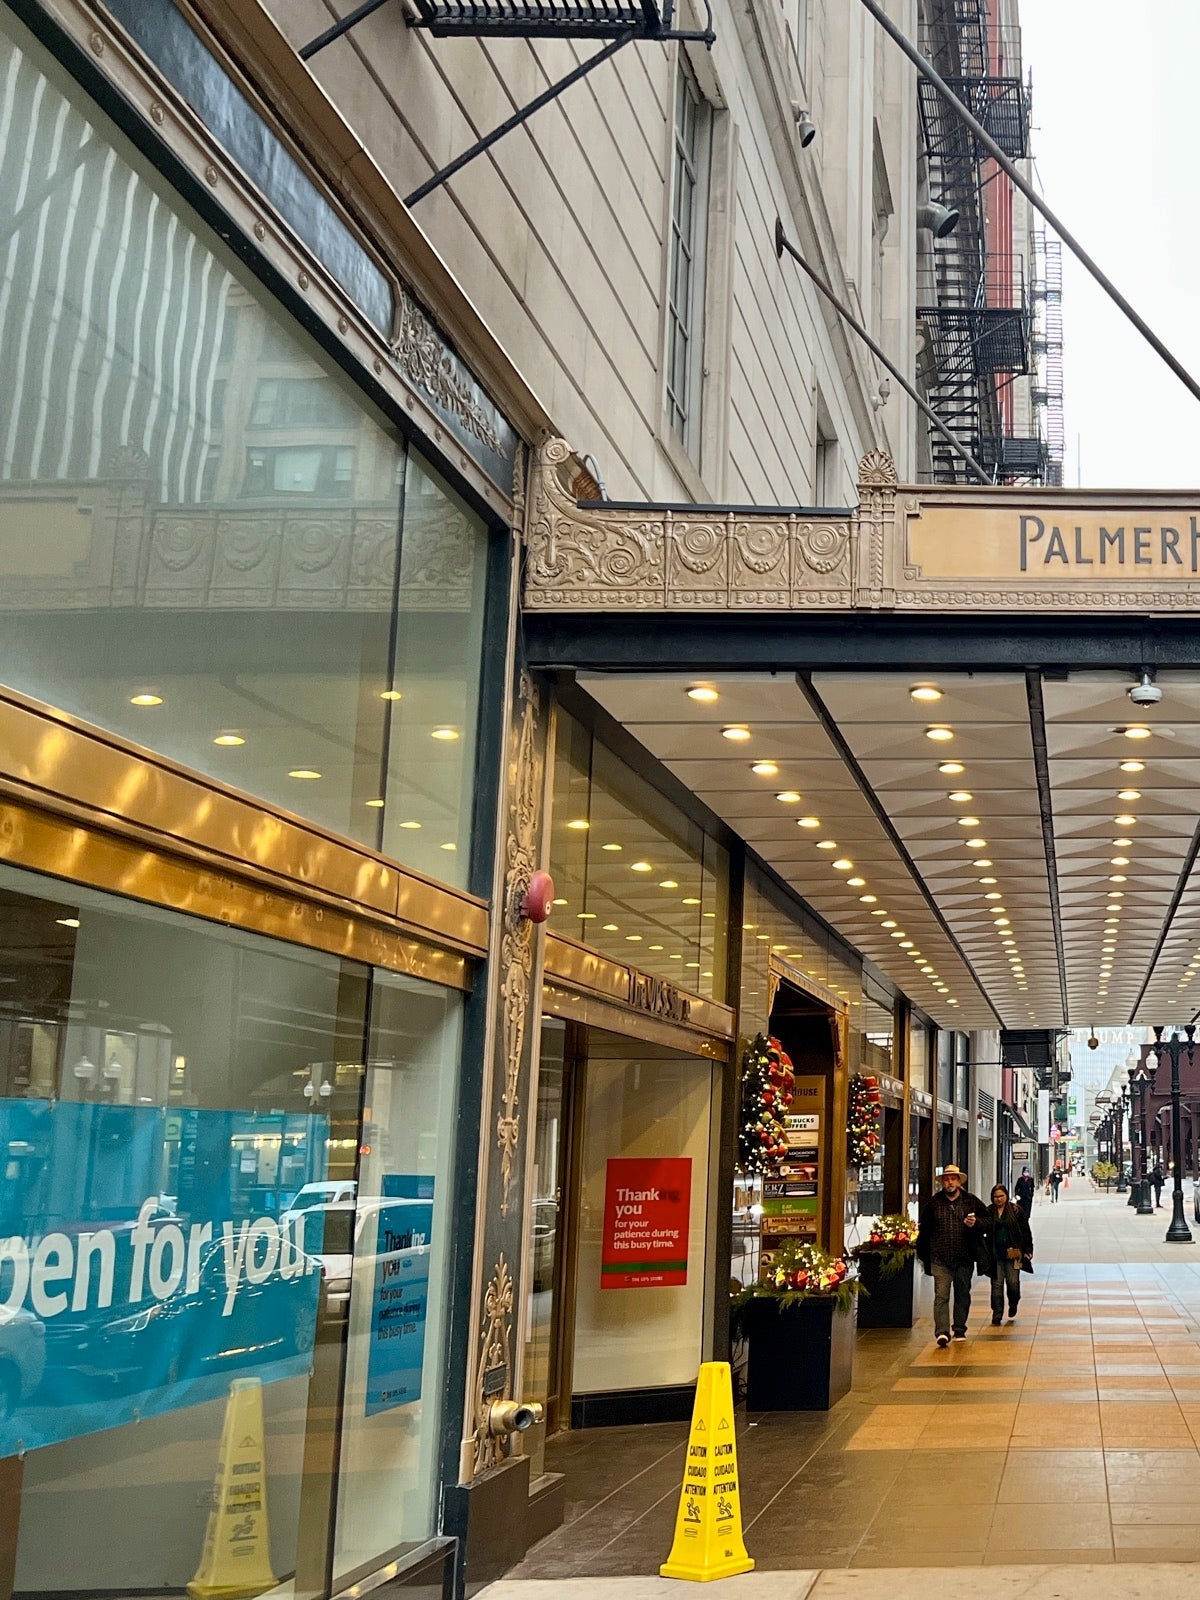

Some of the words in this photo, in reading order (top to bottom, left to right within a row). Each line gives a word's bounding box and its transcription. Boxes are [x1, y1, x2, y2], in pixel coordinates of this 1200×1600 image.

[615, 1204, 642, 1219] you
[615, 1220, 628, 1229] for
[628, 1220, 650, 1230] your
[613, 1230, 651, 1241] patience
[651, 1229, 680, 1239] during
[128, 1195, 213, 1303] for
[613, 1240, 630, 1250] this
[630, 1240, 652, 1251] busy
[652, 1240, 675, 1248] time.
[382, 1258, 401, 1284] you
[379, 1287, 391, 1302] for
[390, 1287, 404, 1304] your
[377, 1326, 389, 1340] this
[689, 1445, 707, 1458] CAUTION
[714, 1443, 733, 1457] CAUTION
[687, 1465, 707, 1478] CUIDADO
[714, 1462, 735, 1477] CUIDADO
[684, 1483, 707, 1497] ATTENTION
[713, 1481, 737, 1496] ATTENTION
